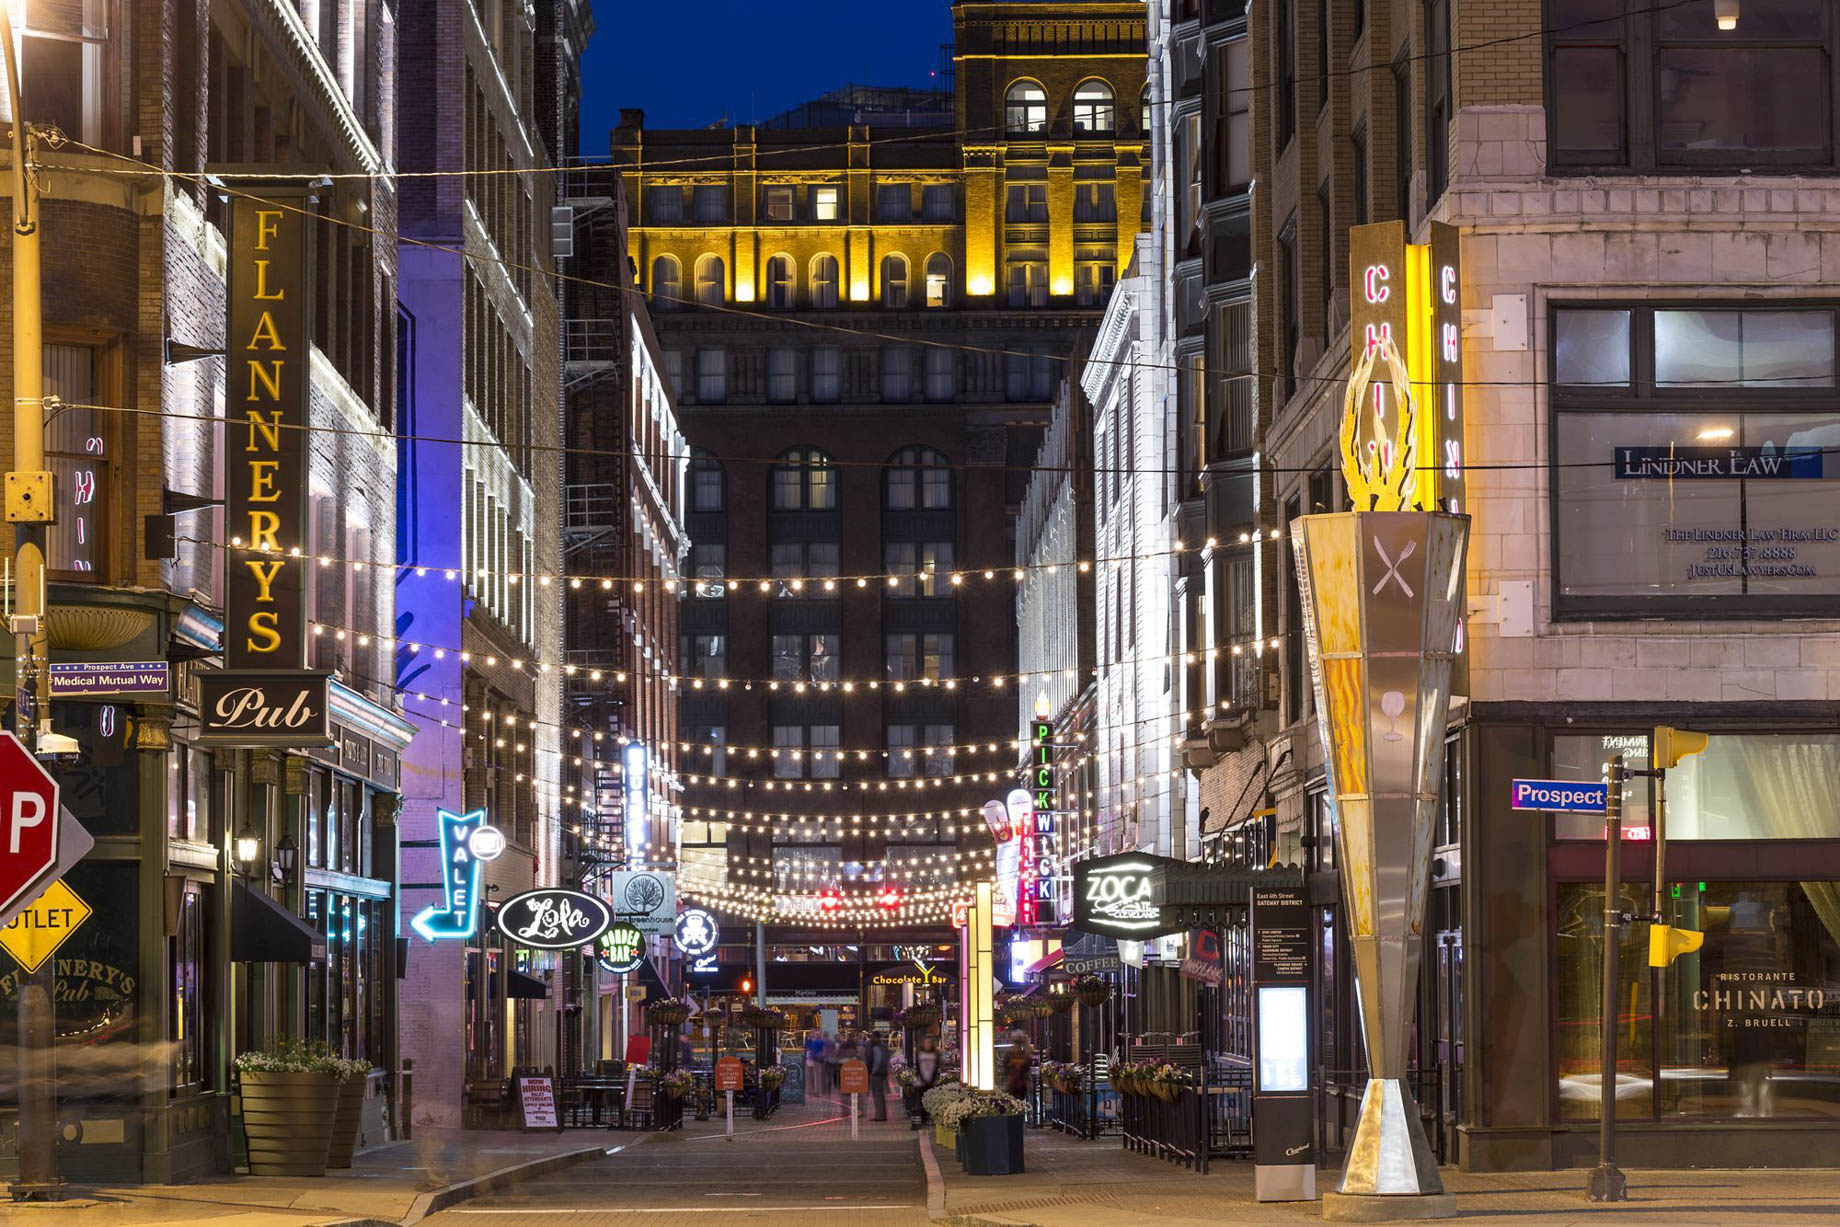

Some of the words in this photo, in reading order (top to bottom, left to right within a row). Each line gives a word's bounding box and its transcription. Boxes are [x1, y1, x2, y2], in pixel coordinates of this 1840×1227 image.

[245, 210, 287, 653] FLANNERYS
[1624, 450, 1724, 475] LINDNER
[1729, 450, 1783, 475] LAW
[1666, 528, 1690, 541] THE
[1694, 528, 1746, 541] LINDNER
[1750, 528, 1777, 541] LAW
[1780, 528, 1810, 541] FIRM
[1814, 528, 1839, 541] LLC
[54, 676, 96, 686] Medical
[99, 675, 137, 685] Mutual
[139, 675, 164, 686] Way
[209, 687, 318, 728] Pub
[1518, 784, 1603, 807] Prospect
[453, 825, 468, 927] VALET
[518, 898, 590, 938] Lola
[601, 929, 640, 946] WONDER
[610, 946, 630, 962] BAR
[1065, 957, 1119, 974] COFFEE
[873, 975, 922, 985] Chocolate
[932, 975, 947, 984] Bar
[1720, 973, 1796, 981] RISTORANTE
[1693, 990, 1824, 1010] CHINATO
[1727, 1019, 1738, 1027] Z.
[1745, 1019, 1791, 1027] BRUELL
[522, 1085, 552, 1093] HIRING
